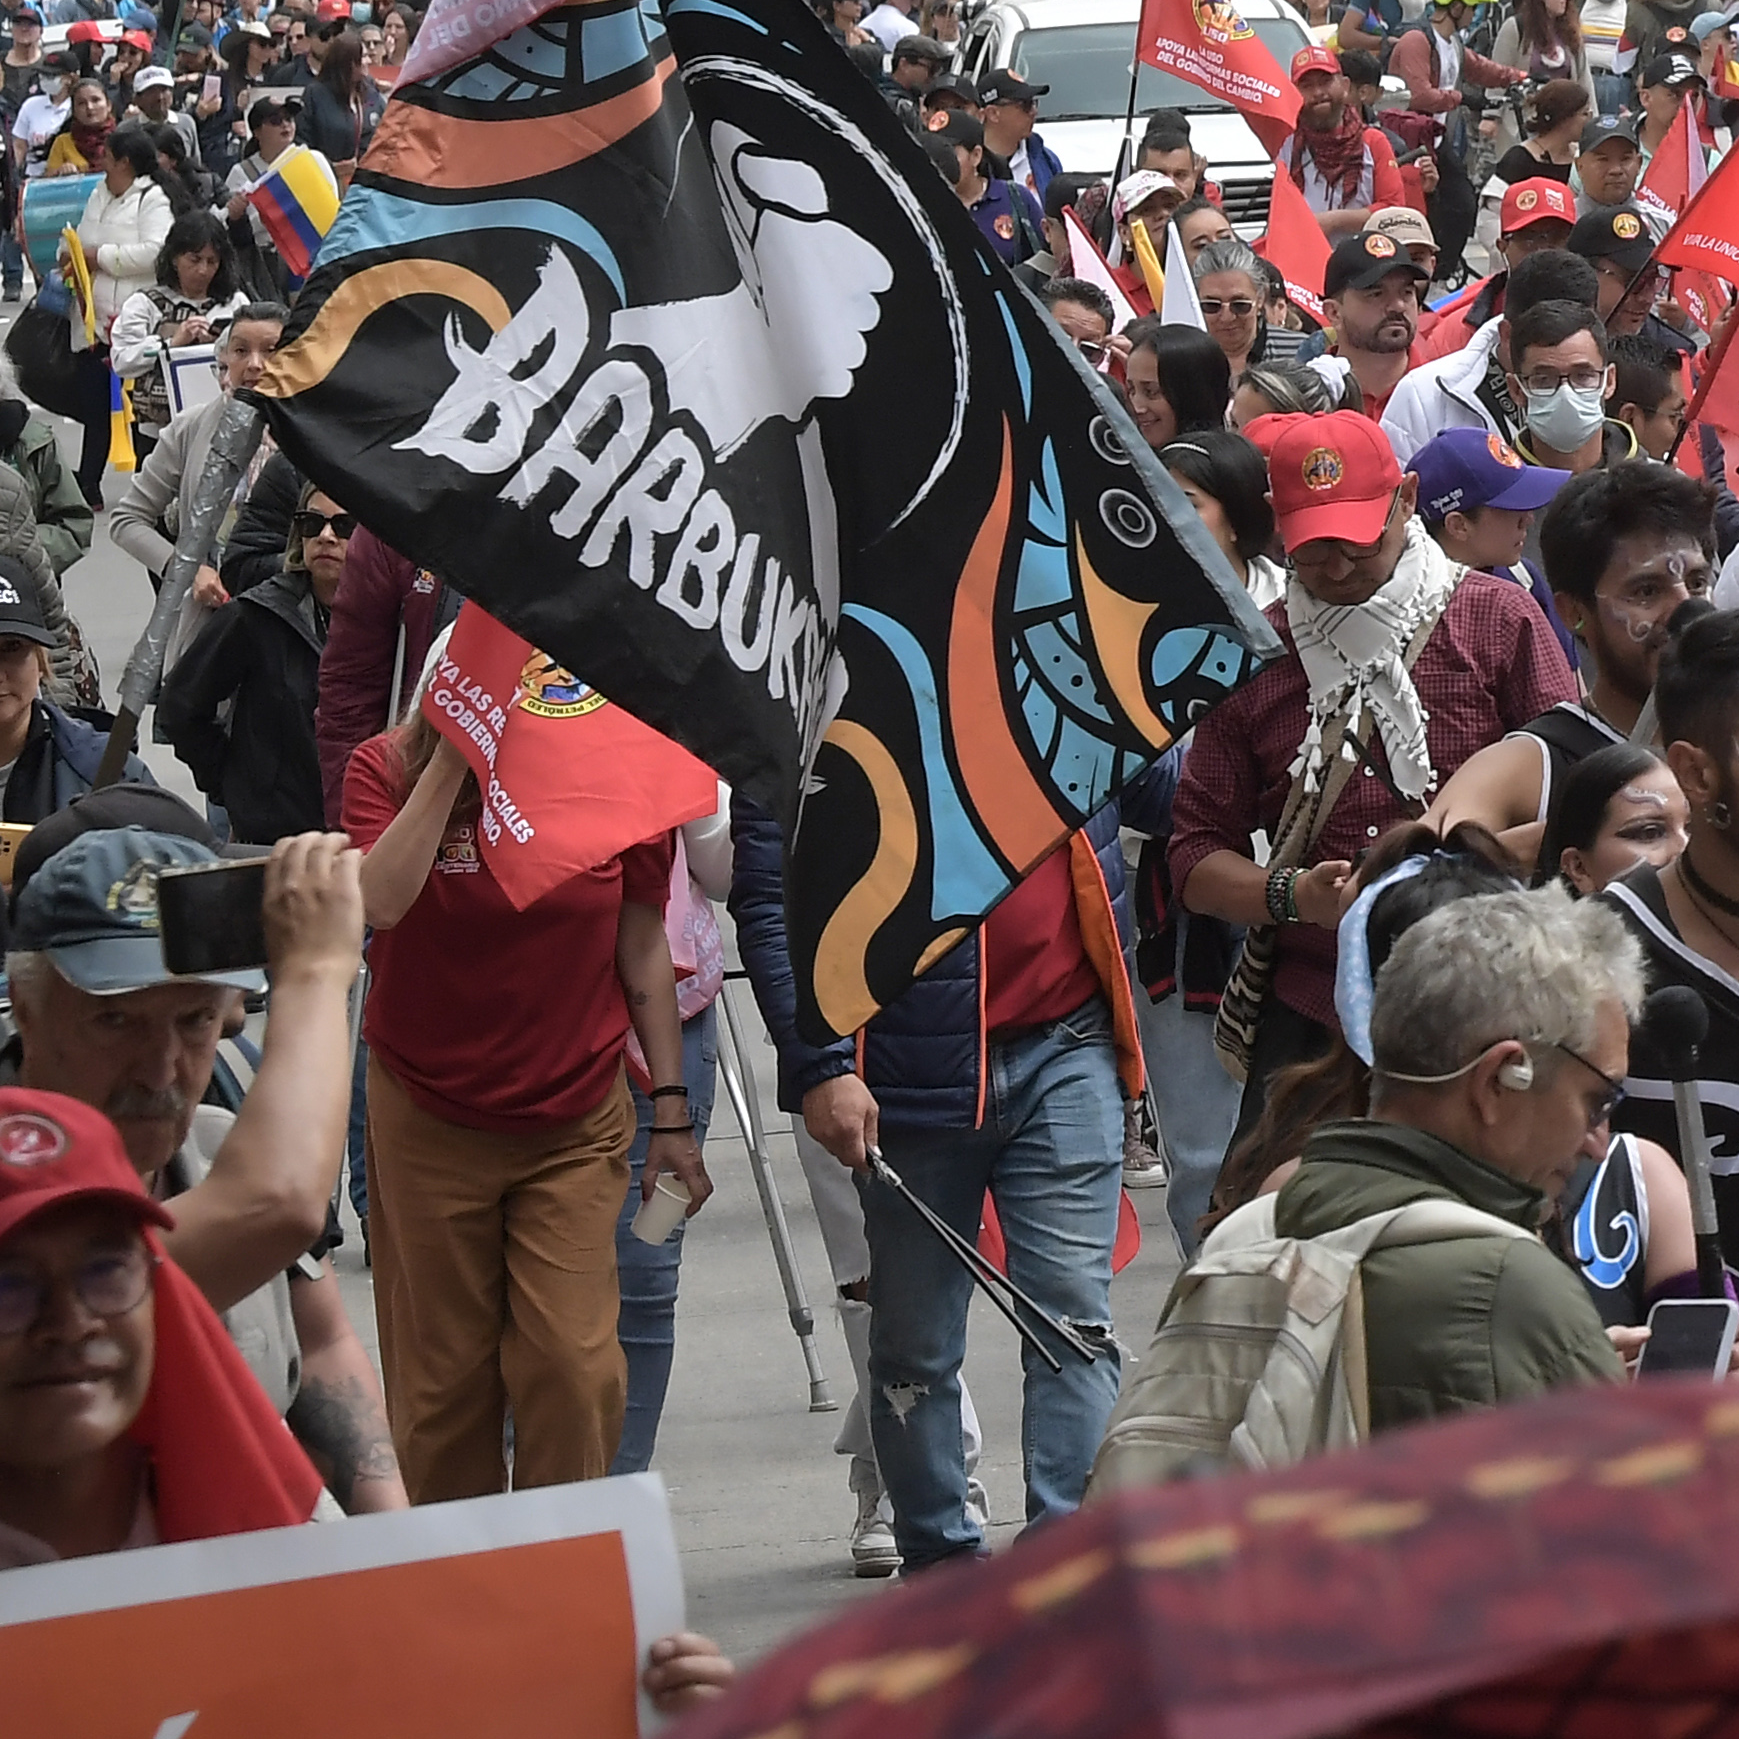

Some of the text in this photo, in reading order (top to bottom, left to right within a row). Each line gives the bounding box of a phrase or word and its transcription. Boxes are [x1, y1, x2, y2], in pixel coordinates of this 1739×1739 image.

[1377, 217, 1423, 231] Colombia
[458, 673, 493, 714] LAS
[433, 690, 498, 769] GOBIERN
